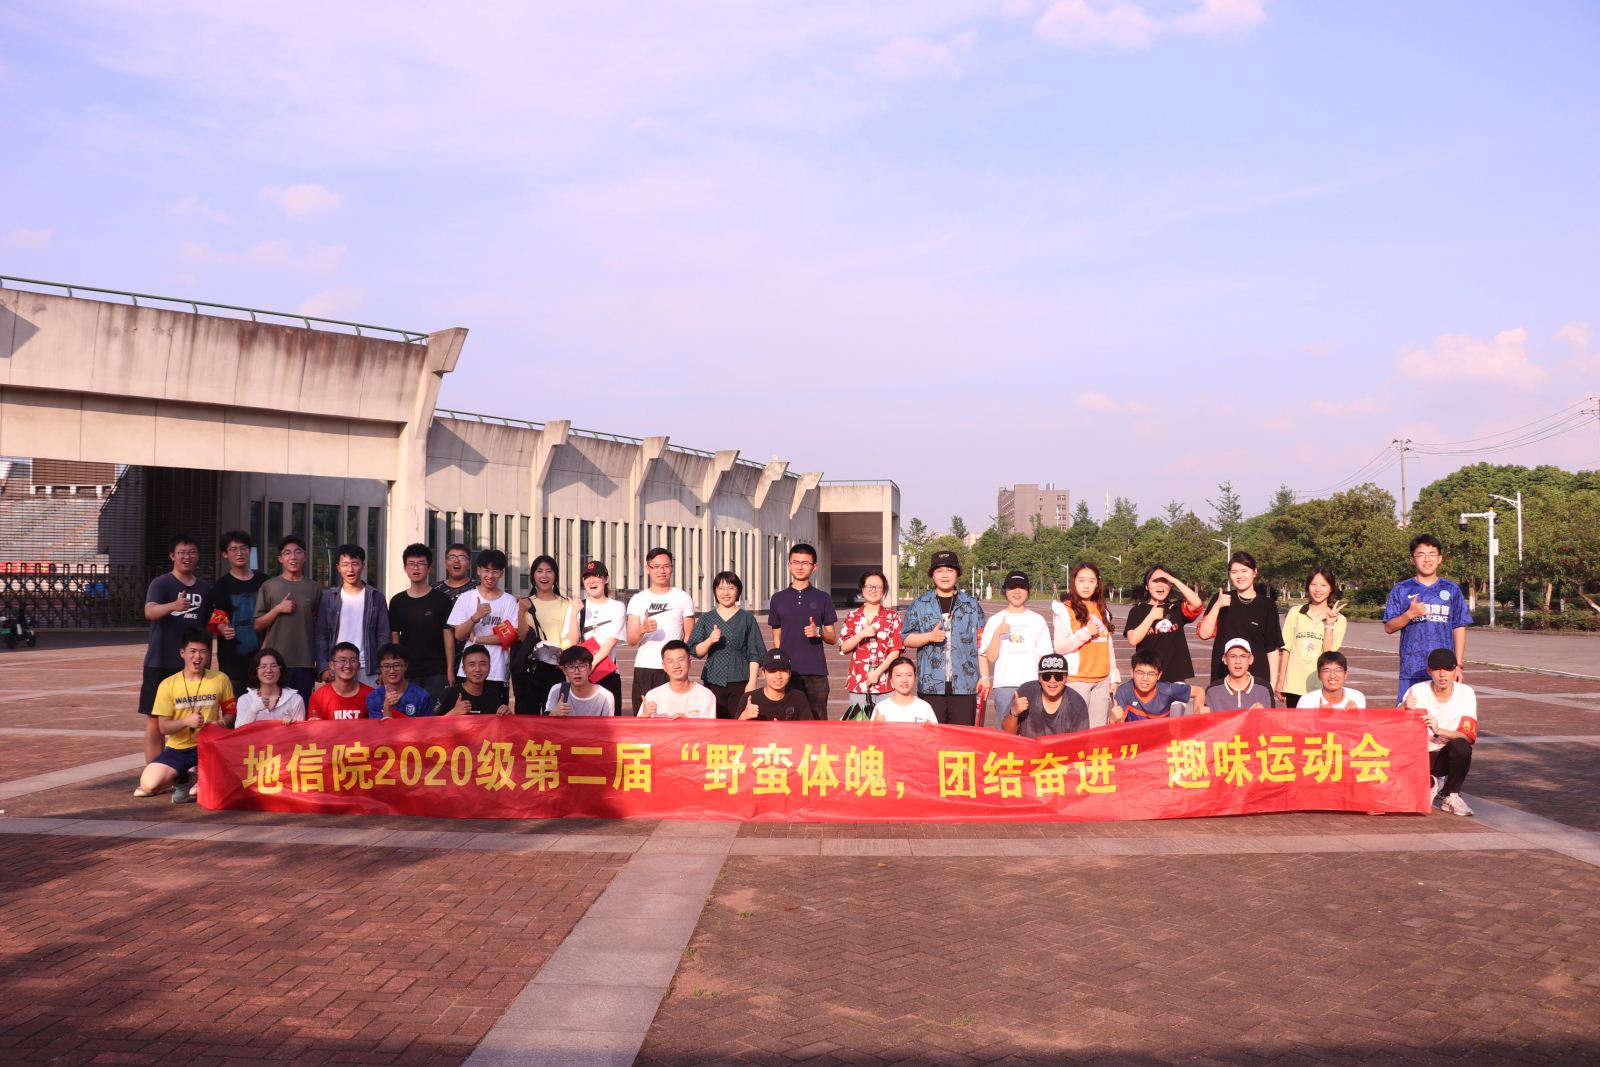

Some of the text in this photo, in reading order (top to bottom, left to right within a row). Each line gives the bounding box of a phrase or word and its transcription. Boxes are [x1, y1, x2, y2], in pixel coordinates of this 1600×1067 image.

[649, 602, 669, 610] NIKE
[175, 694, 217, 704] WARRIORS
[242, 739, 653, 795] 地信院2020级第二届
[1166, 732, 1392, 788] 趣味运动会
